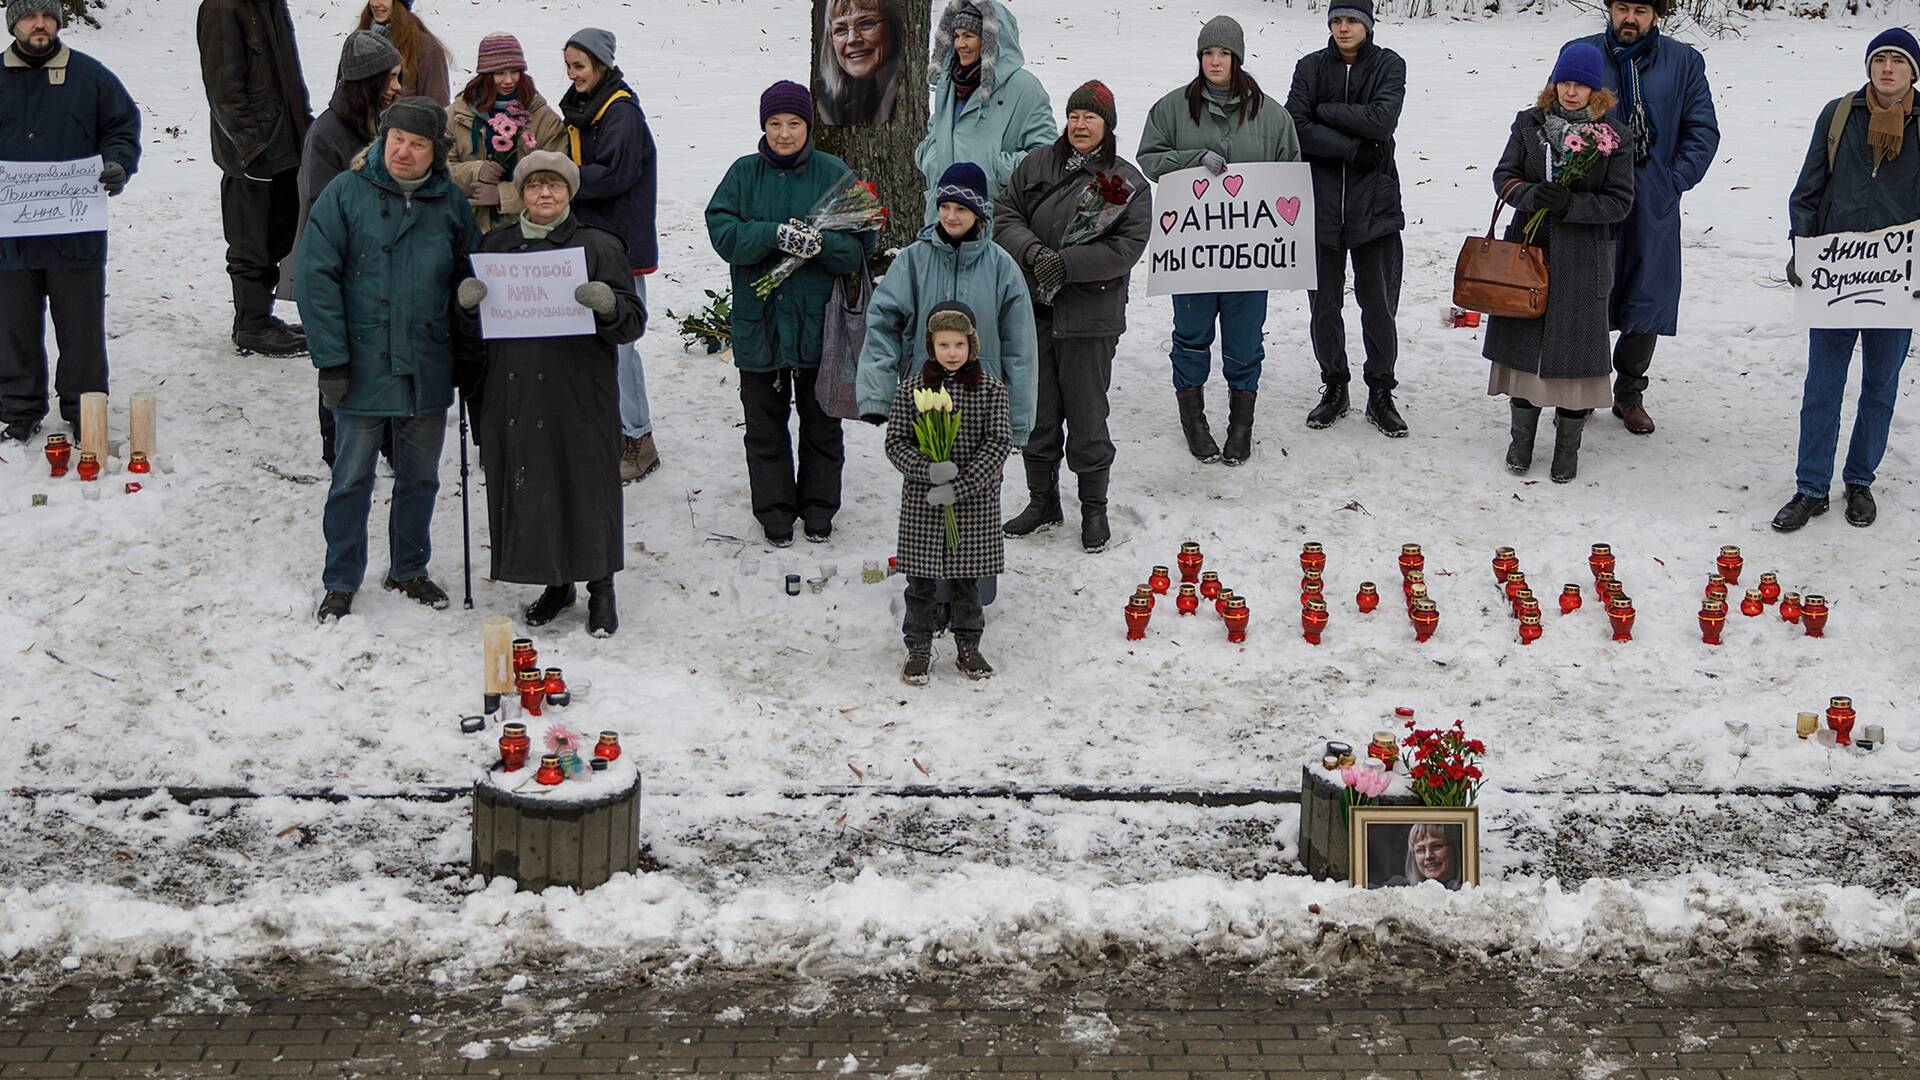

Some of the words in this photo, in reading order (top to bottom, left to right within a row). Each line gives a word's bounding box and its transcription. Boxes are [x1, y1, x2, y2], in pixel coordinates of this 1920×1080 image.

[1180, 200, 1278, 233] АННА
[1152, 246, 1187, 274] МЫ
[1818, 236, 1880, 263] Анна
[509, 264, 519, 278] С
[522, 260, 573, 278] ТОБОЙ
[1811, 259, 1912, 295] Держись!
[507, 283, 549, 302] АННА
